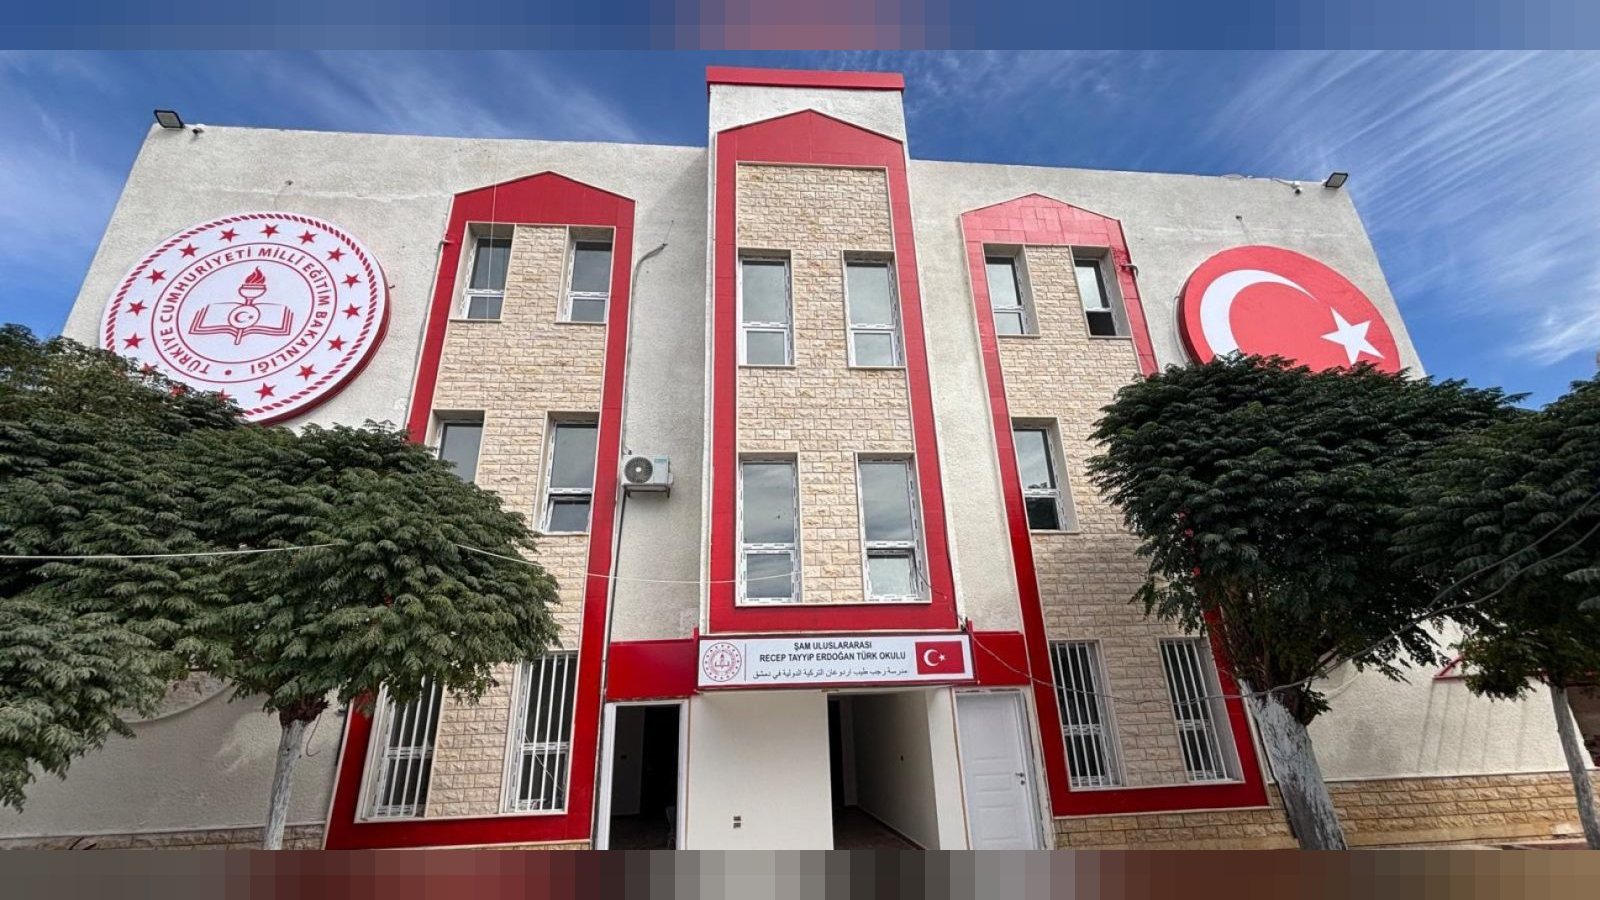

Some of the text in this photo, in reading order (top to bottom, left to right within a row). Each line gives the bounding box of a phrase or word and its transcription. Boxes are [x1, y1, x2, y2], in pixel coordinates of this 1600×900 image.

[160, 246, 332, 375] TÜRKİYE CUMHURİYETİ MİLLİ EĞİTİM BAKANLIĞI
[793, 641, 872, 651] ŞAM ULUSLARARASI
[759, 654, 786, 662] RECEP
[816, 651, 854, 661] ERDOĞAN
[856, 650, 878, 660] TÜRK
[879, 651, 906, 660] OKULU
